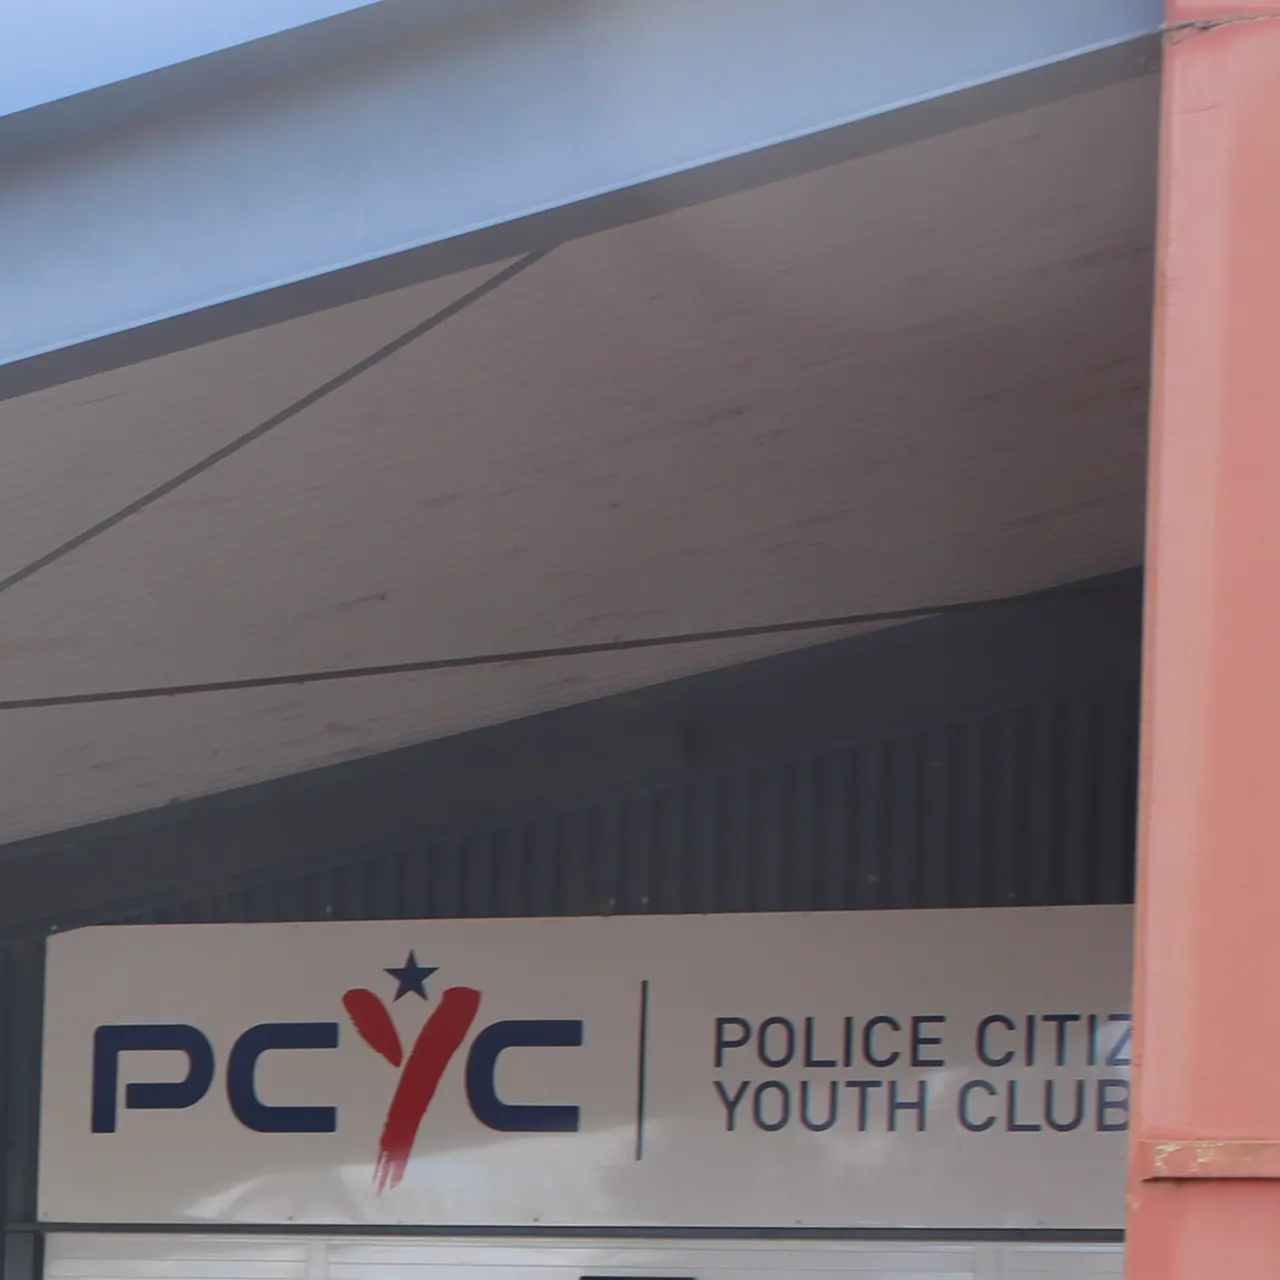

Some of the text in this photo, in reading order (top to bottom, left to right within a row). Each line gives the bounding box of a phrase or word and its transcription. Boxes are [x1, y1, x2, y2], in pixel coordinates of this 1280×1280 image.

[713, 1015, 945, 1069] POLICE
[90, 986, 583, 1194] PCYC
[713, 1078, 1129, 1132] YOUTH CLUB
